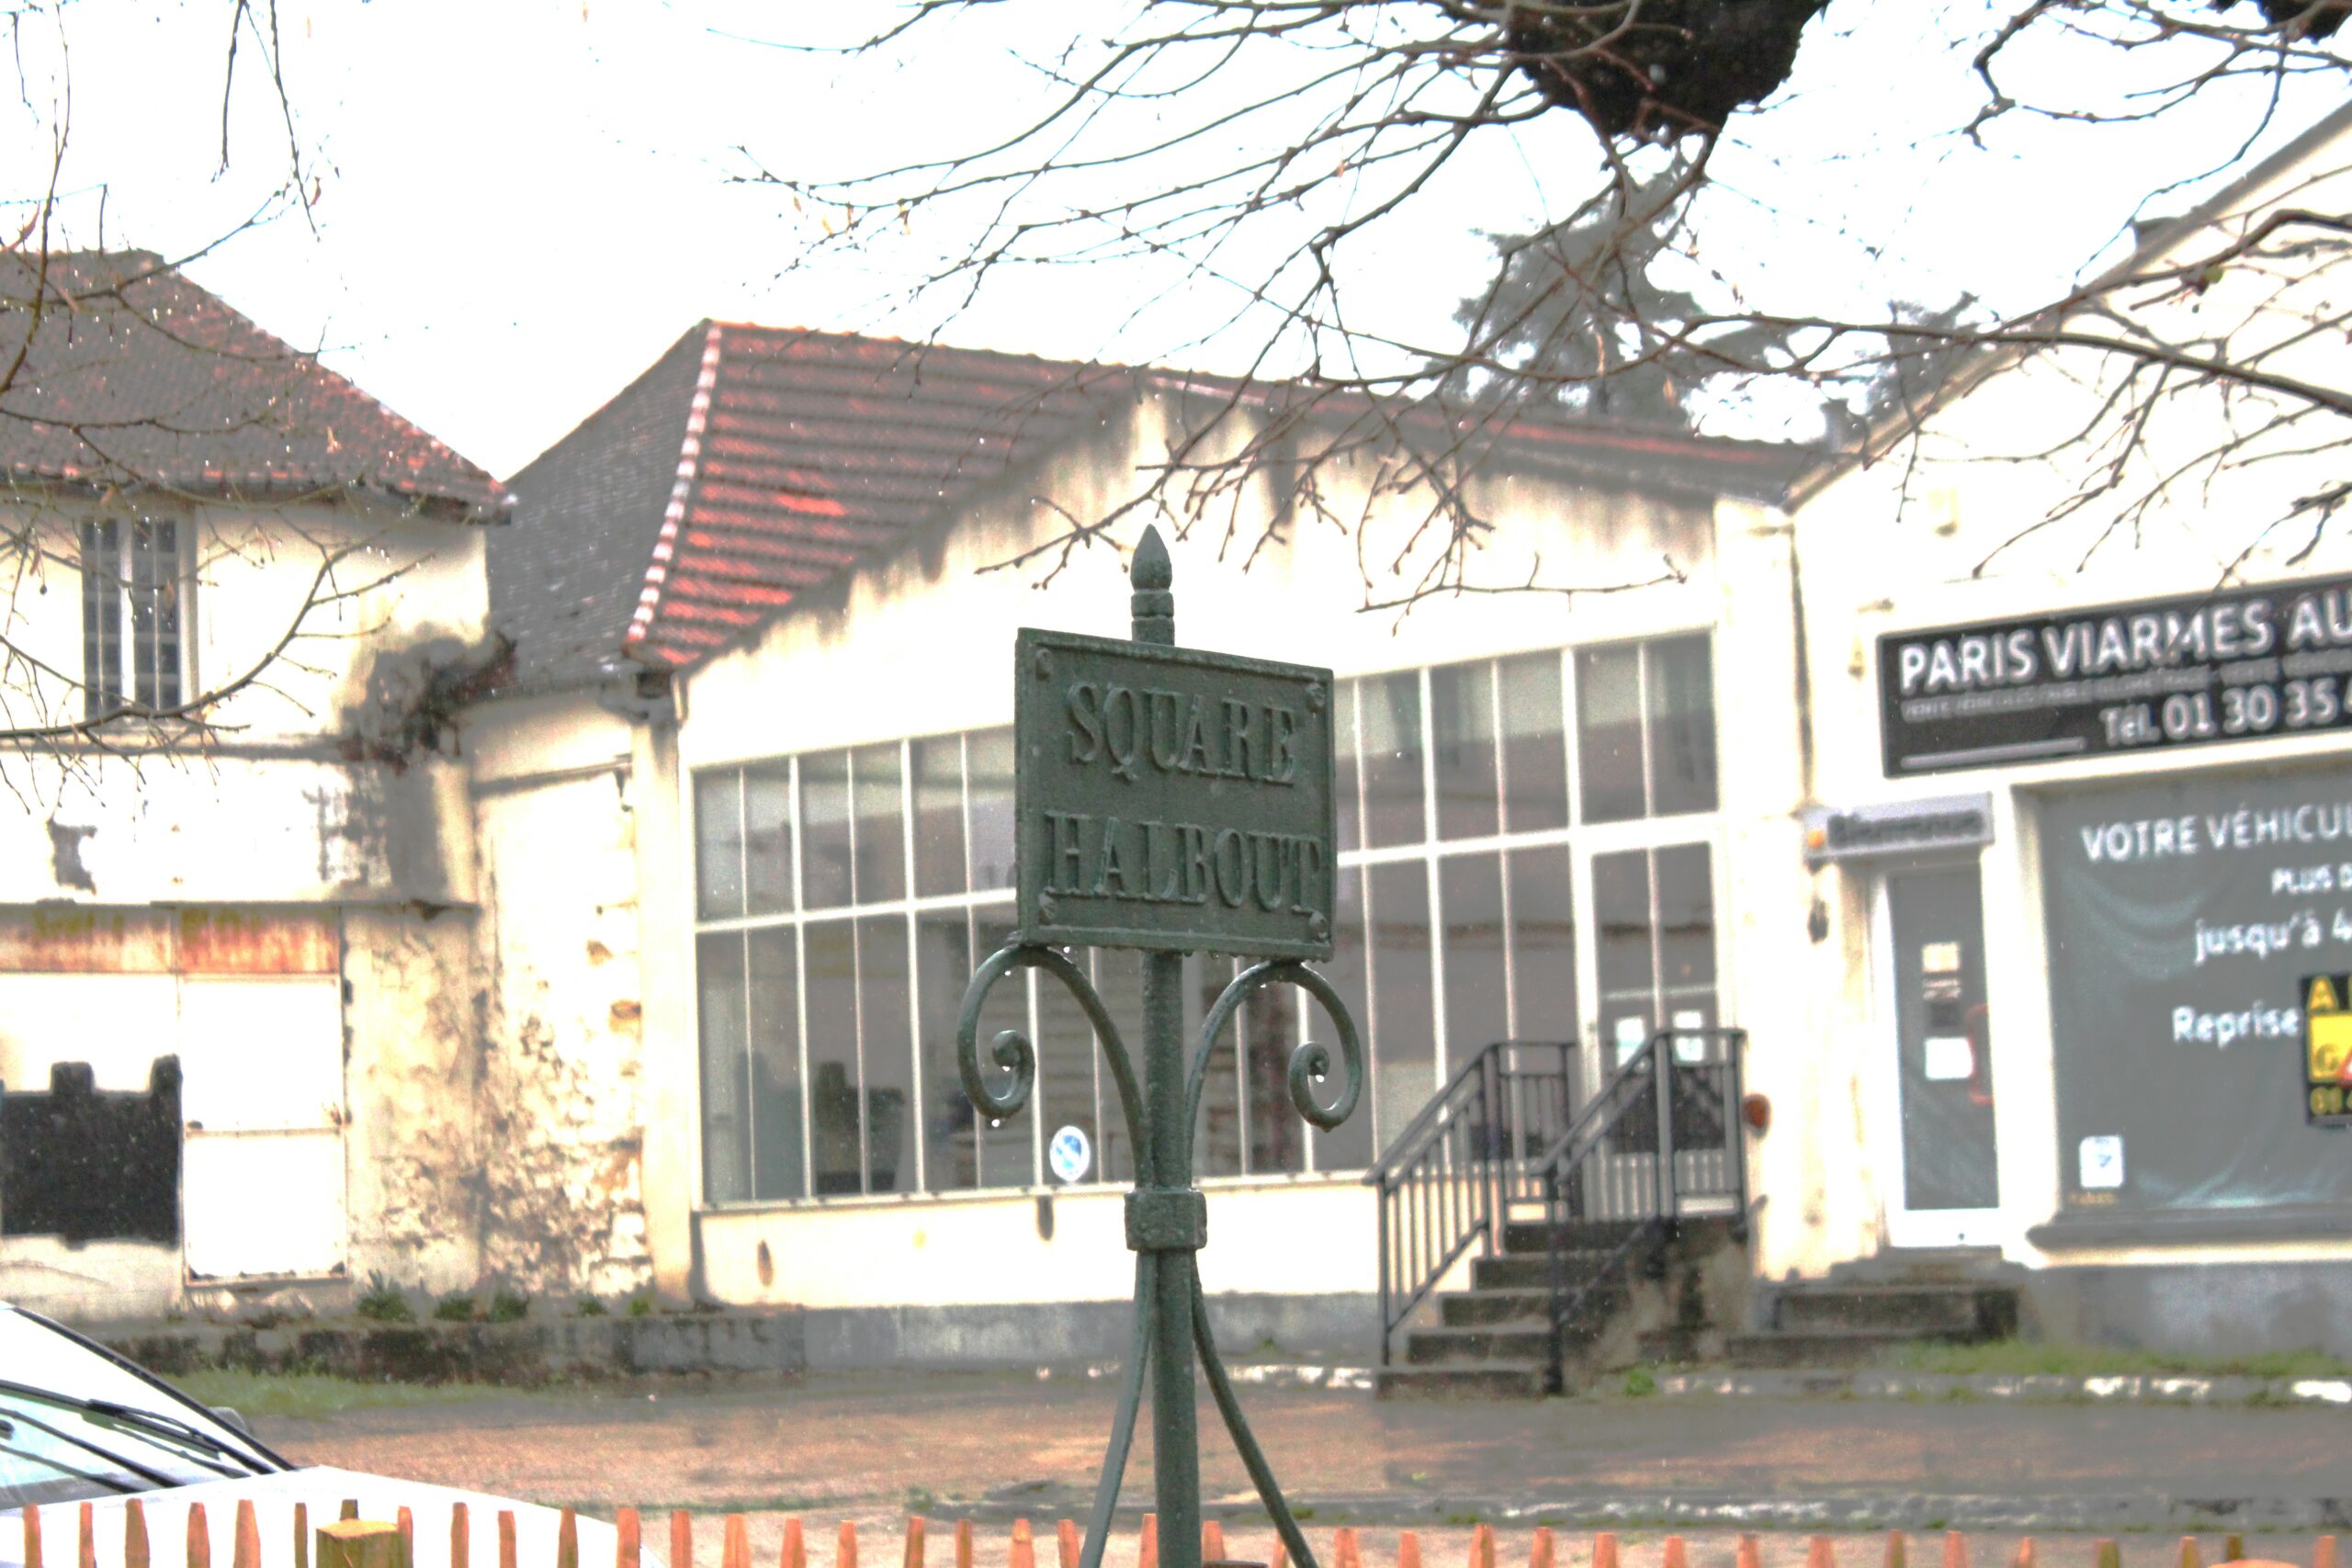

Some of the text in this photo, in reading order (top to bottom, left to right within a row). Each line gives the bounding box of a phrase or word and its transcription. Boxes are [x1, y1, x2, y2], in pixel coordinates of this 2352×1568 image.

[1898, 626, 2036, 695] PARIS
[2041, 596, 2274, 678] VIARMES
[1066, 682, 1295, 788] SQUARE
[2163, 693, 2217, 739] 01
[2222, 683, 2278, 733] 30
[2284, 676, 2340, 727] 35
[1044, 808, 1323, 915] HALBOUT
[2082, 815, 2199, 862] VOTRE
[2194, 908, 2322, 965] jusqu'à
[2172, 1001, 2299, 1049] Reprise
